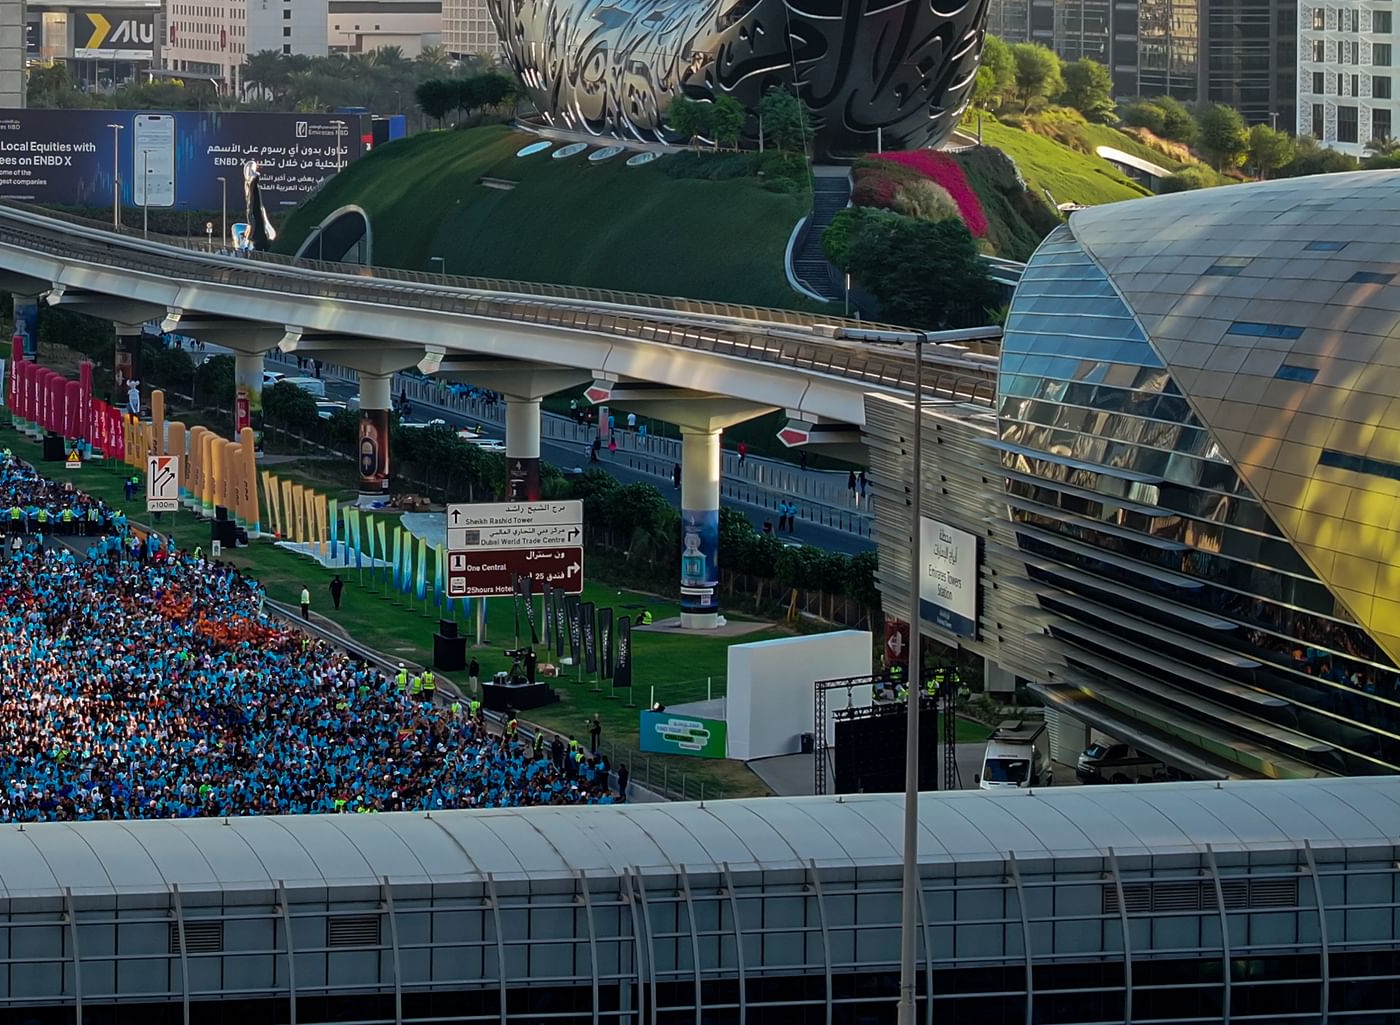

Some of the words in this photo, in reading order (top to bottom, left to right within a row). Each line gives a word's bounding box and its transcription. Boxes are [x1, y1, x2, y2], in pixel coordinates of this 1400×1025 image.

[1, 141, 28, 151] Local
[30, 142, 71, 153] Equities
[73, 142, 96, 152] with
[207, 145, 240, 154] الأسهم
[243, 145, 258, 154] على
[260, 147, 285, 155] رسوم
[289, 145, 298, 157] أي
[301, 146, 321, 155] بدون
[34, 156, 62, 166] ENBD
[65, 156, 72, 166] X
[214, 158, 238, 166] ENBD
[240, 158, 246, 166] X
[278, 159, 298, 168] خلال
[300, 160, 312, 168] من
[505, 505, 524, 513] راشد
[528, 504, 549, 513] الشيخ
[526, 551, 552, 560] سنترال
[546, 572, 564, 581] فندق
[929, 564, 946, 582] Emirates
[947, 571, 962, 589] Towers
[938, 584, 952, 600] Station
